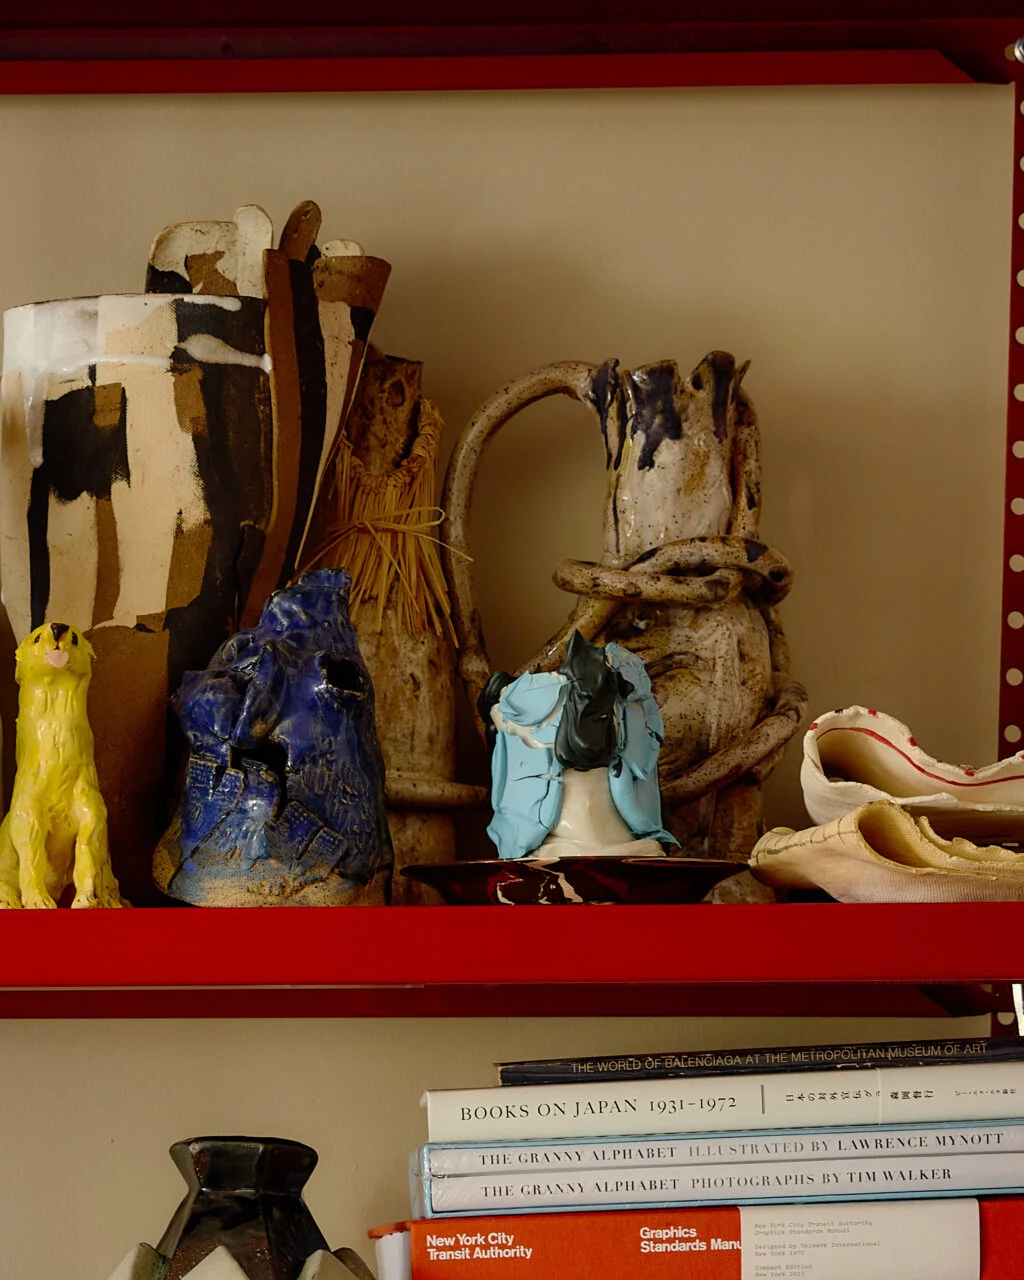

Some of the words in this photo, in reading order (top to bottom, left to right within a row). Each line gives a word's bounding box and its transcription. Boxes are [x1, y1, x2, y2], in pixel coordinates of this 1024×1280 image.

[572, 1063, 594, 1073] THE
[597, 1060, 641, 1072] WORLD
[645, 1057, 661, 1069] OF
[665, 1056, 742, 1068] BALENCIAGA
[744, 1054, 760, 1065] AT
[765, 1053, 788, 1063] THE
[791, 1048, 888, 1062] METROPOLITAN
[888, 1045, 941, 1058] MUSEUM
[944, 1045, 961, 1054] OF
[964, 1043, 988, 1054] ART
[460, 1103, 529, 1121] BOOKS
[538, 1103, 566, 1116] ON
[574, 1099, 637, 1118] JAPAN
[649, 1097, 737, 1114] 1931-1972
[479, 1154, 512, 1165] THE
[519, 1151, 583, 1164] GRANNY
[592, 1147, 676, 1160] ALPHABET
[689, 1141, 804, 1157] ILLUSTRATED
[811, 1140, 829, 1152] BY
[838, 1137, 928, 1151] LAWRENCE
[935, 1133, 1004, 1146] MYNOTT
[482, 1186, 514, 1198] THE
[521, 1182, 585, 1195] GRANNY
[593, 1179, 679, 1193] ALPHABET
[692, 1174, 815, 1190] PHOTOGRAPHS
[822, 1173, 840, 1184] BY
[847, 1171, 876, 1182] TIM
[883, 1169, 952, 1181] WALKER
[427, 1235, 455, 1247] New
[457, 1233, 485, 1246] York
[488, 1233, 514, 1247] City
[640, 1227, 696, 1240] Graphics
[427, 1247, 470, 1260] Transit
[473, 1246, 532, 1261] Authority
[640, 1239, 707, 1253] Standards
